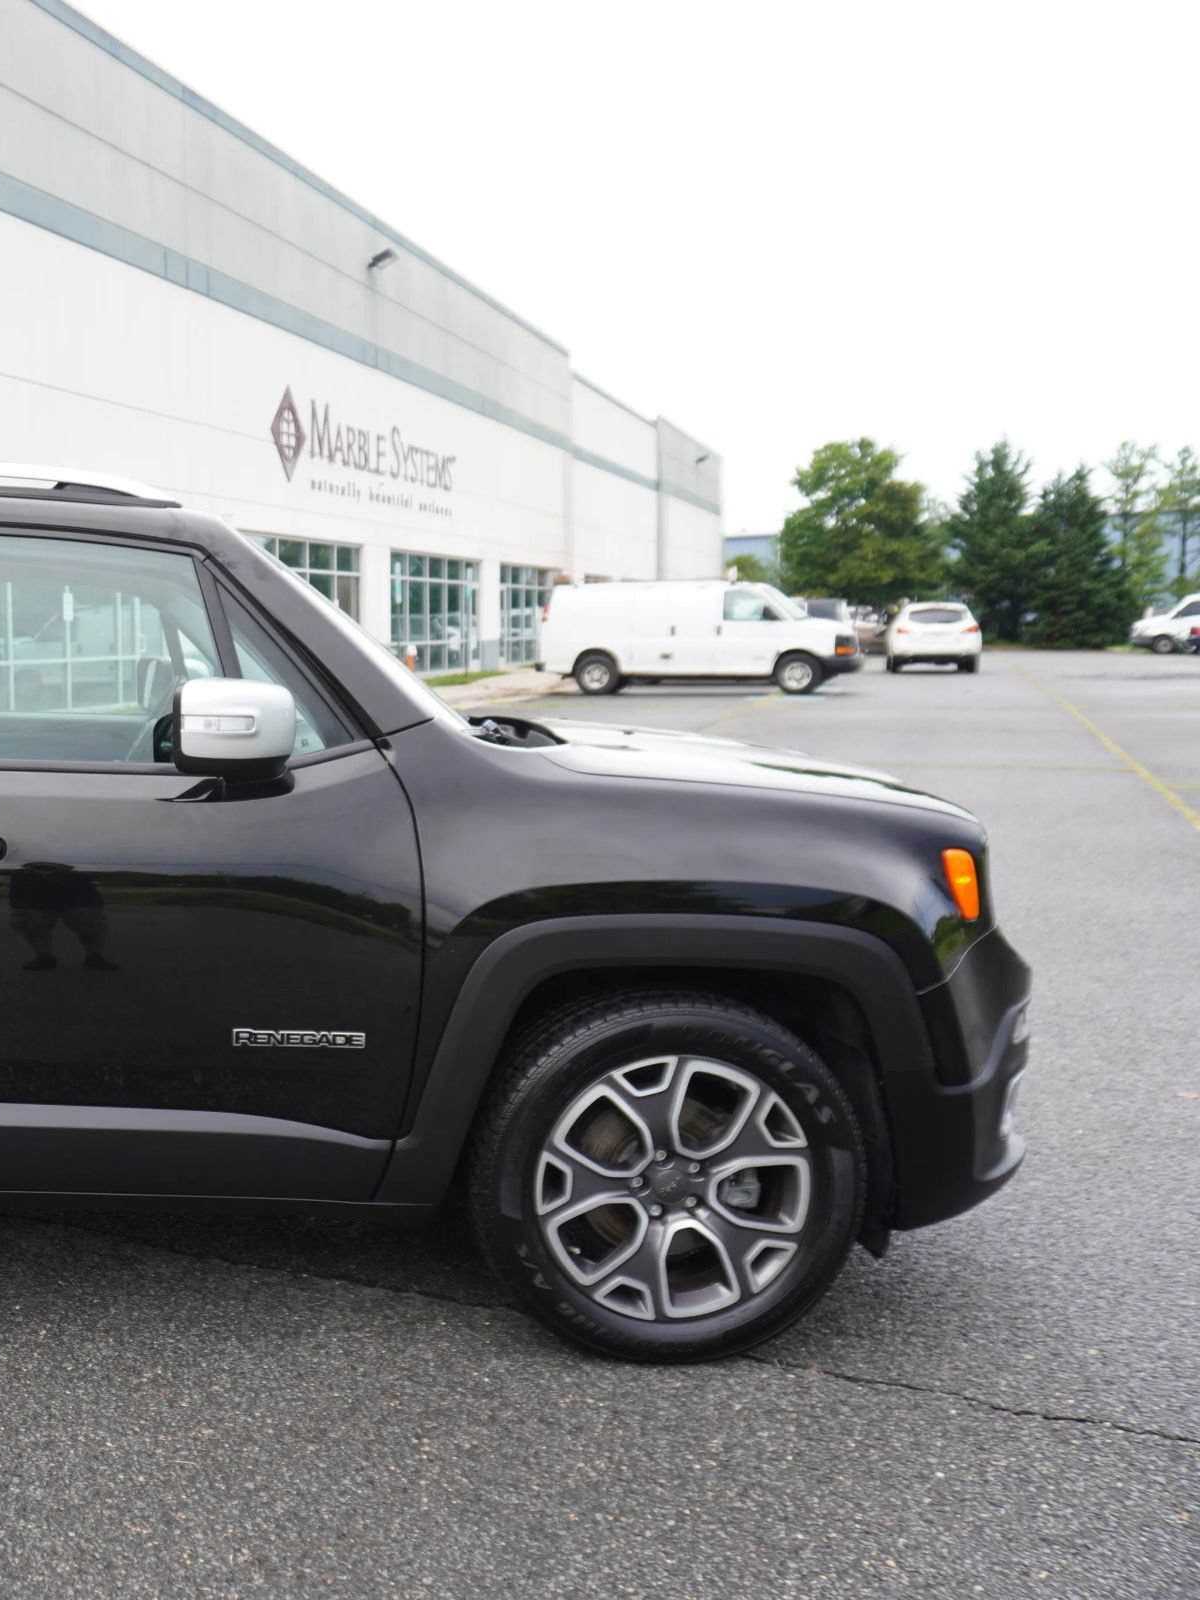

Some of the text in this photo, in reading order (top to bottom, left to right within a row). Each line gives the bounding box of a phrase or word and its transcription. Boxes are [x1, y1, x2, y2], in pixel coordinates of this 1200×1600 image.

[309, 398, 386, 476] MARBLE
[310, 479, 452, 517] naturally beautiful surfaces
[232, 1028, 366, 1048] RENEGADE
